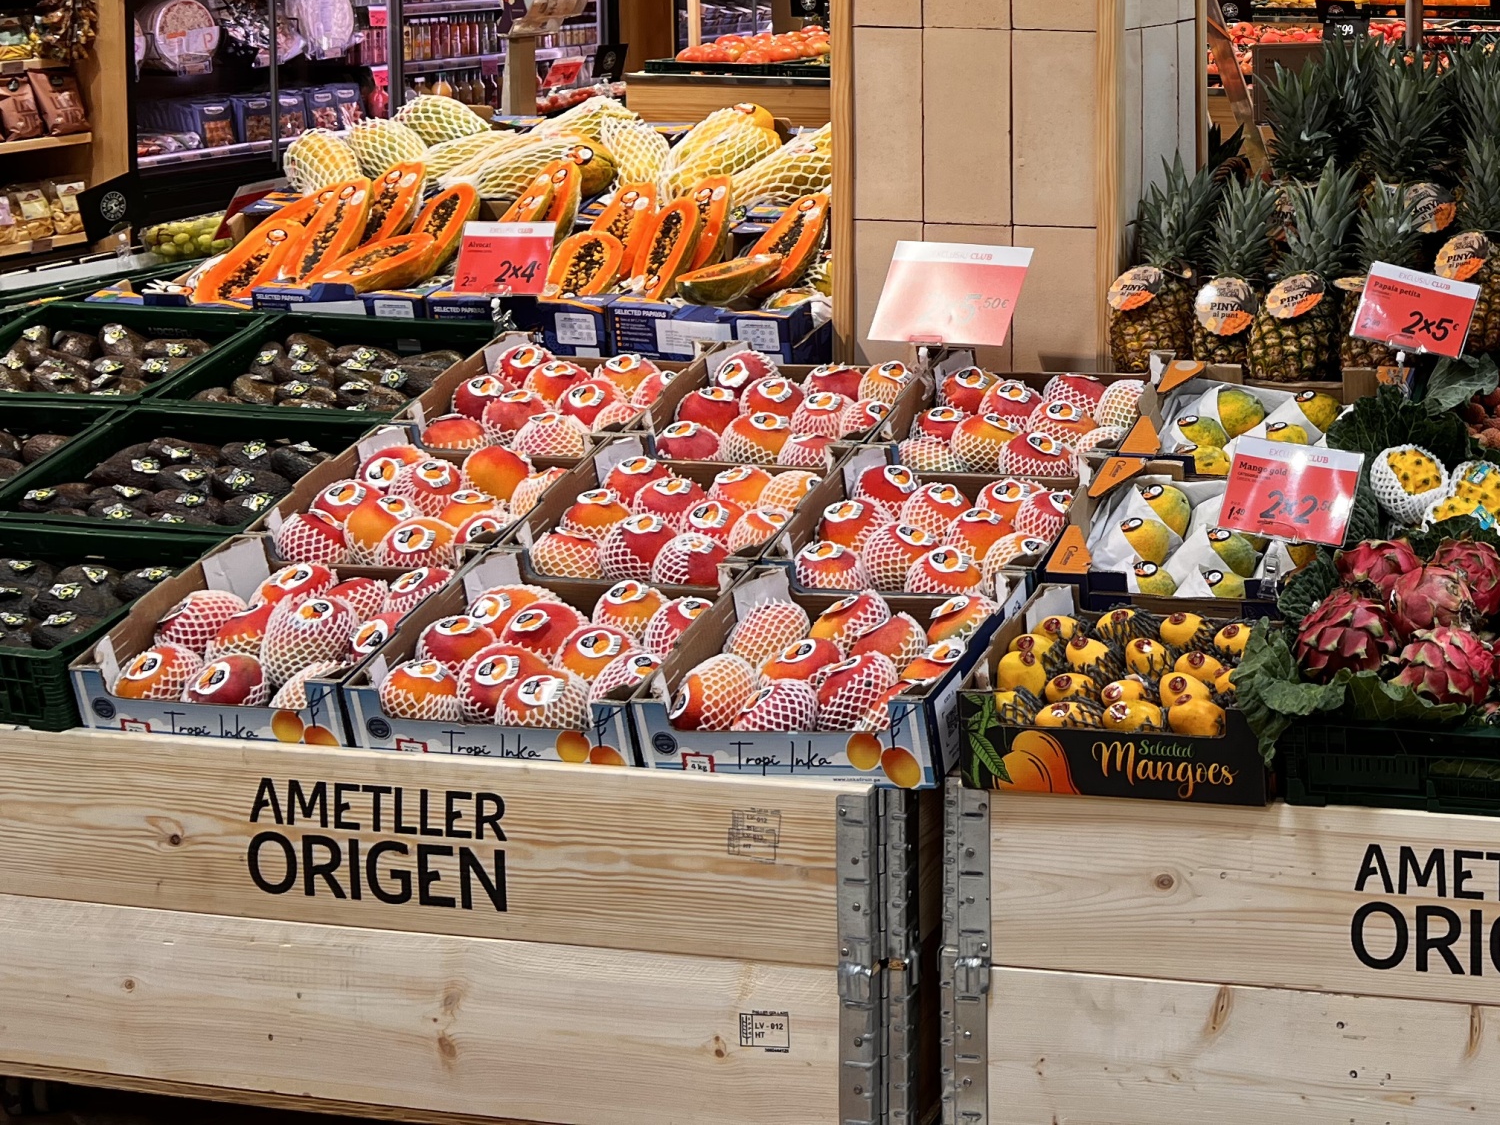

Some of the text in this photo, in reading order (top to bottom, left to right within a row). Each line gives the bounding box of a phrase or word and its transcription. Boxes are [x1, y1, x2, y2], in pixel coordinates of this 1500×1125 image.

[970, 253, 994, 261] CLUB
[1374, 281, 1421, 298] Papaia petita
[1398, 273, 1451, 291] EXCLUSIU CLUB
[256, 293, 282, 302] SELECTED
[433, 306, 462, 314] SELECTED
[614, 308, 667, 319] SELECTED PAPAYAS
[1210, 302, 1243, 312] PINYA
[1238, 461, 1288, 476] Mango gold
[163, 711, 258, 739] Tropi Inka
[442, 730, 541, 759] Tropi Inka
[1138, 739, 1195, 758] Selected
[729, 741, 832, 776] Tropi Inka
[698, 764, 708, 773] kg
[1091, 741, 1239, 799] Mangoes
[249, 777, 507, 842] AMETLLER
[247, 830, 508, 912] ORIGEN
[754, 1022, 765, 1030] LV
